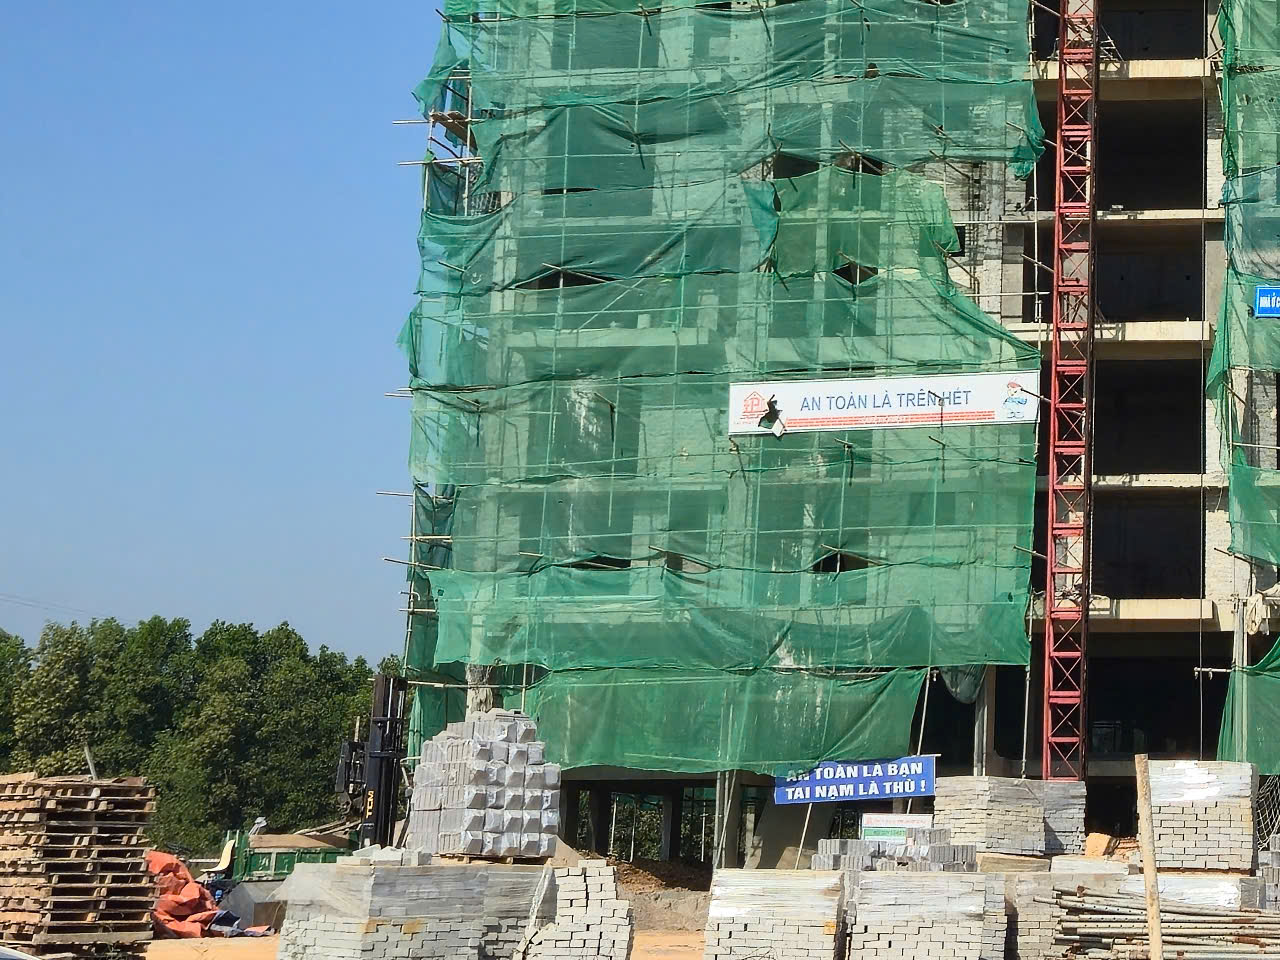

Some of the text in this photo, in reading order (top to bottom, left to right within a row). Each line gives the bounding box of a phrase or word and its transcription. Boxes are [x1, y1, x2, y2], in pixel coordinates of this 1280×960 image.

[800, 397, 820, 411] AN
[826, 392, 867, 411] TOÀN
[873, 390, 892, 409] LÀ
[897, 389, 936, 408] TRÊN
[814, 764, 859, 780] TOÀN
[862, 762, 883, 778] LÀ
[888, 762, 923, 778] BẠN
[785, 786, 811, 800] TAI
[858, 780, 879, 795] LÀ
[883, 780, 915, 794] THÙ
[366, 790, 375, 819] TCM
